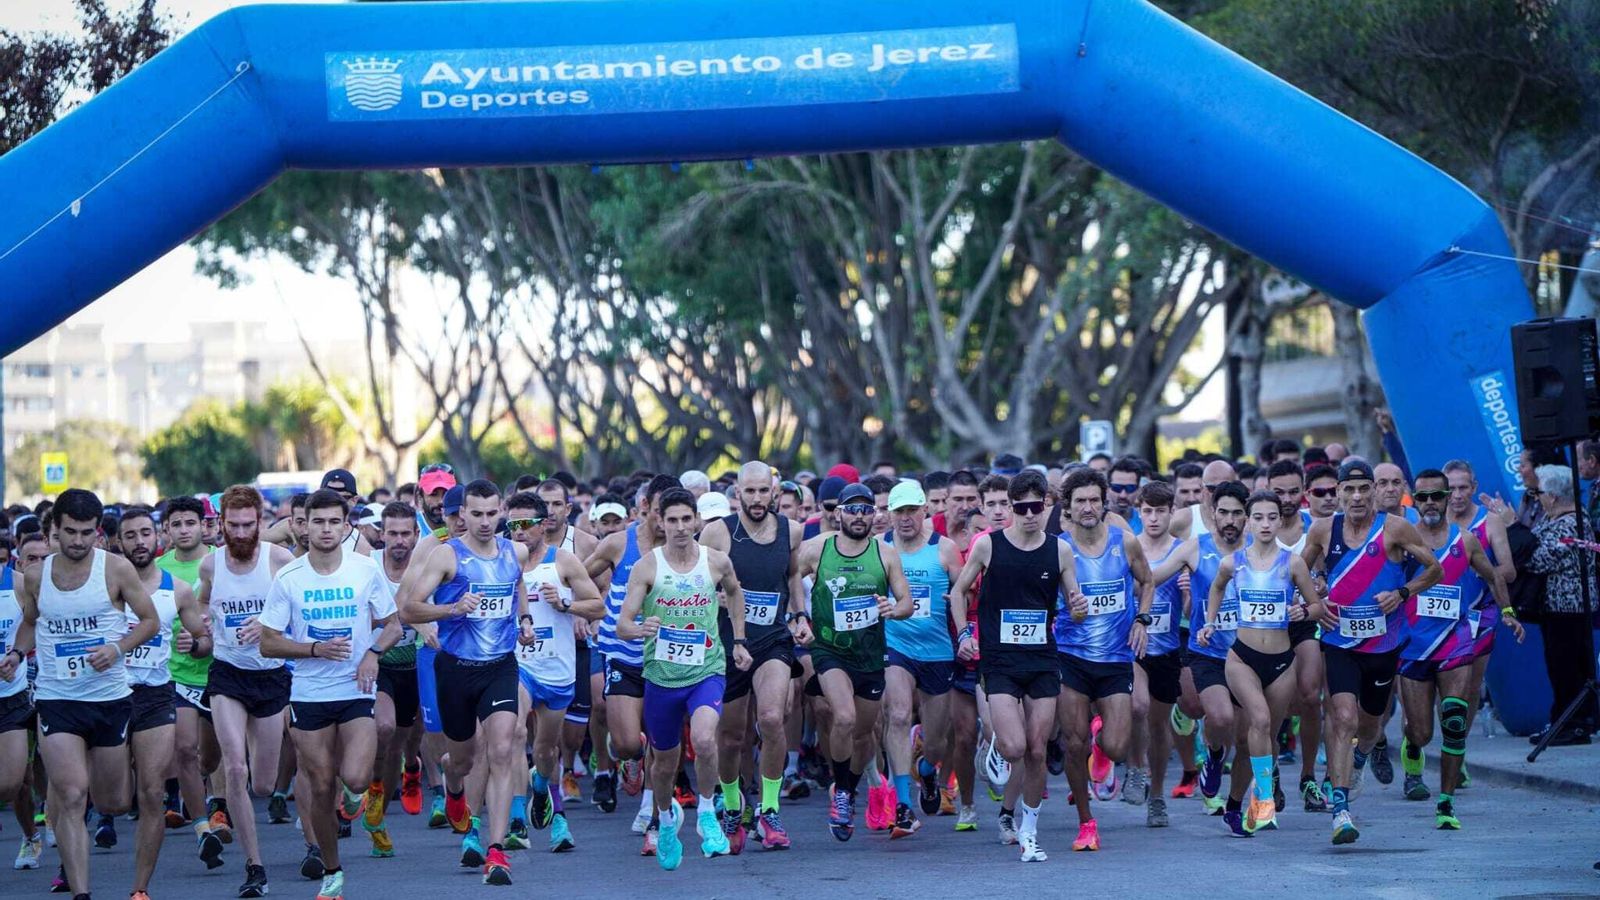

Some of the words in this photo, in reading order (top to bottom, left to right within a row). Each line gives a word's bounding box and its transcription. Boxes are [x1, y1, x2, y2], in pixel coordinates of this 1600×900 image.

[421, 54, 782, 90] Ayuntamiento
[795, 48, 854, 70] de
[868, 43, 996, 72] Jerez
[421, 88, 589, 111] Deportes
[304, 587, 354, 603] PABLO
[1092, 594, 1116, 607] 405
[222, 599, 266, 614] CHAPIN
[480, 598, 504, 611] 861
[913, 600, 920, 610] 5
[1250, 603, 1275, 615] 739
[1427, 598, 1450, 611] 370
[302, 604, 358, 621] SONRIE
[667, 609, 704, 617] JEREZ
[845, 609, 869, 623] 821
[47, 616, 98, 634] CHAPIN
[1012, 624, 1037, 636] 827
[1350, 619, 1376, 631] 888
[667, 642, 693, 657] 575
